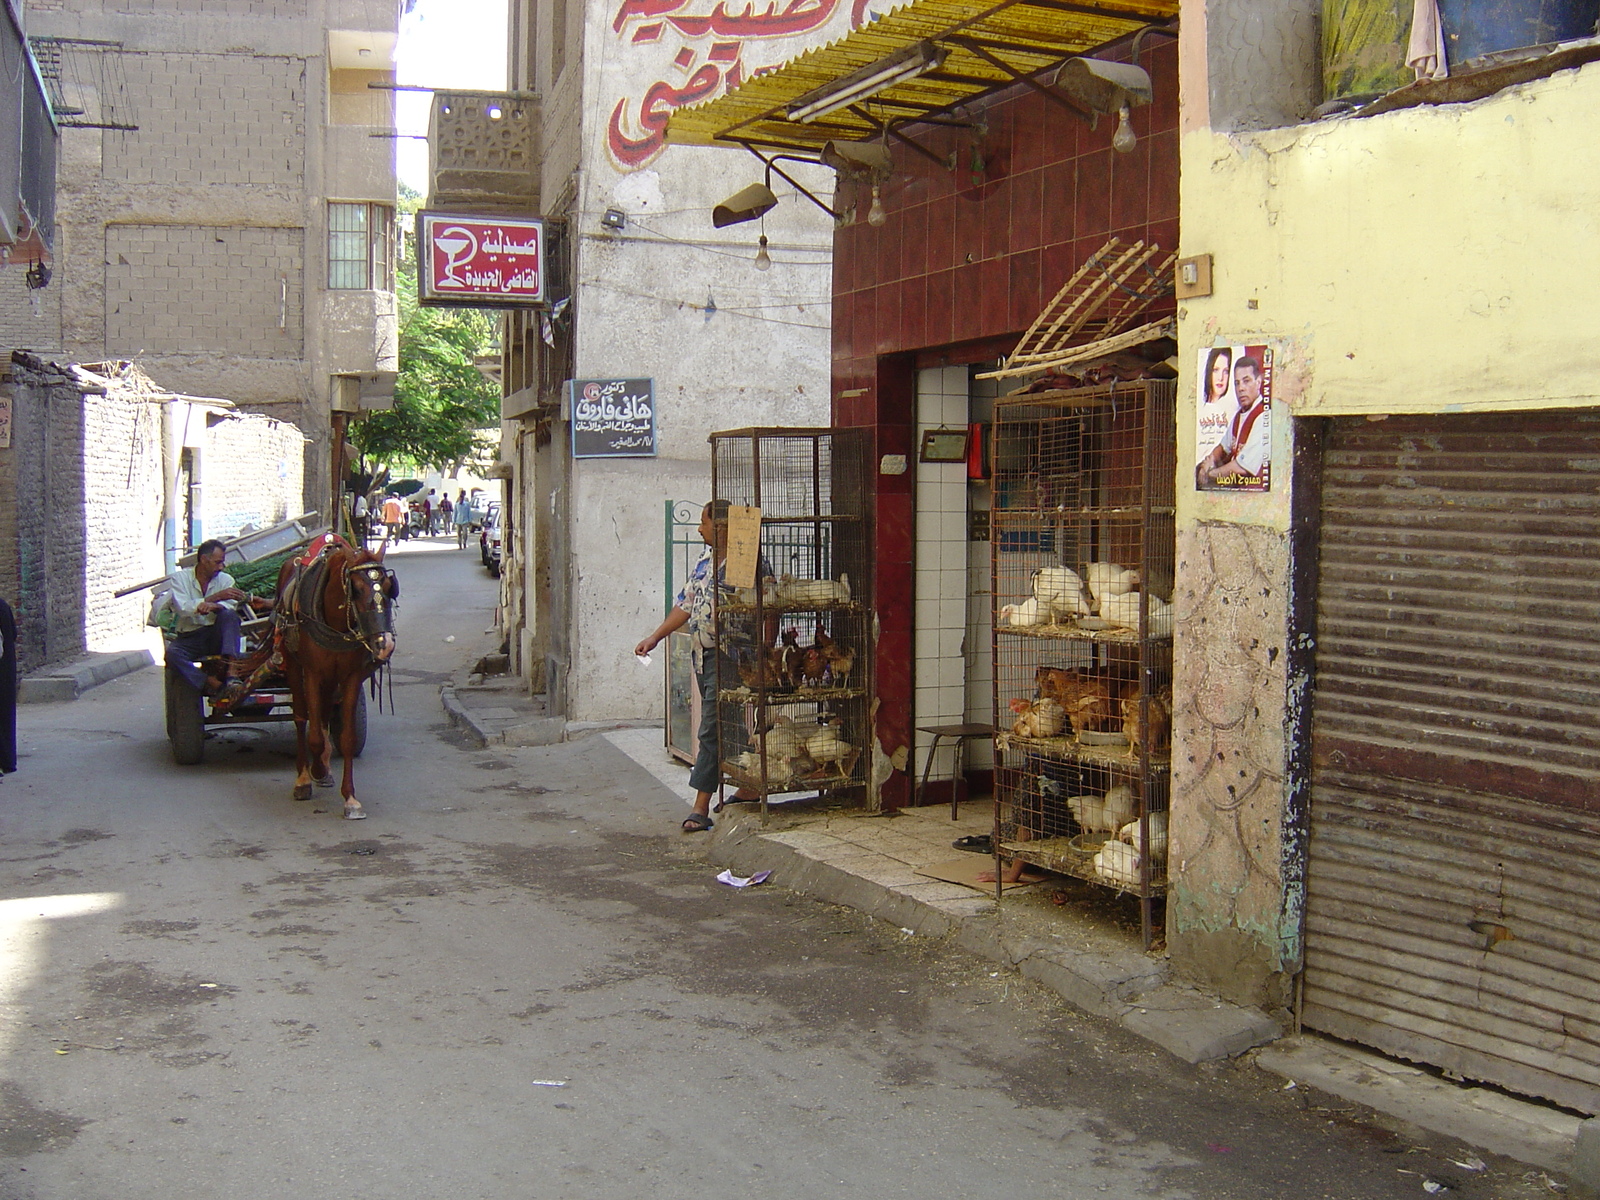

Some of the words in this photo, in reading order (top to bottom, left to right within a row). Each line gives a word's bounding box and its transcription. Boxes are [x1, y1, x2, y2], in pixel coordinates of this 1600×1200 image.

[481, 228, 536, 263] صيدلية
[464, 265, 502, 291] الجديدة
[601, 381, 627, 395] دكتور
[615, 421, 634, 432] وجراح
[633, 419, 651, 433] طبيب
[1237, 473, 1261, 486] ممدوح
